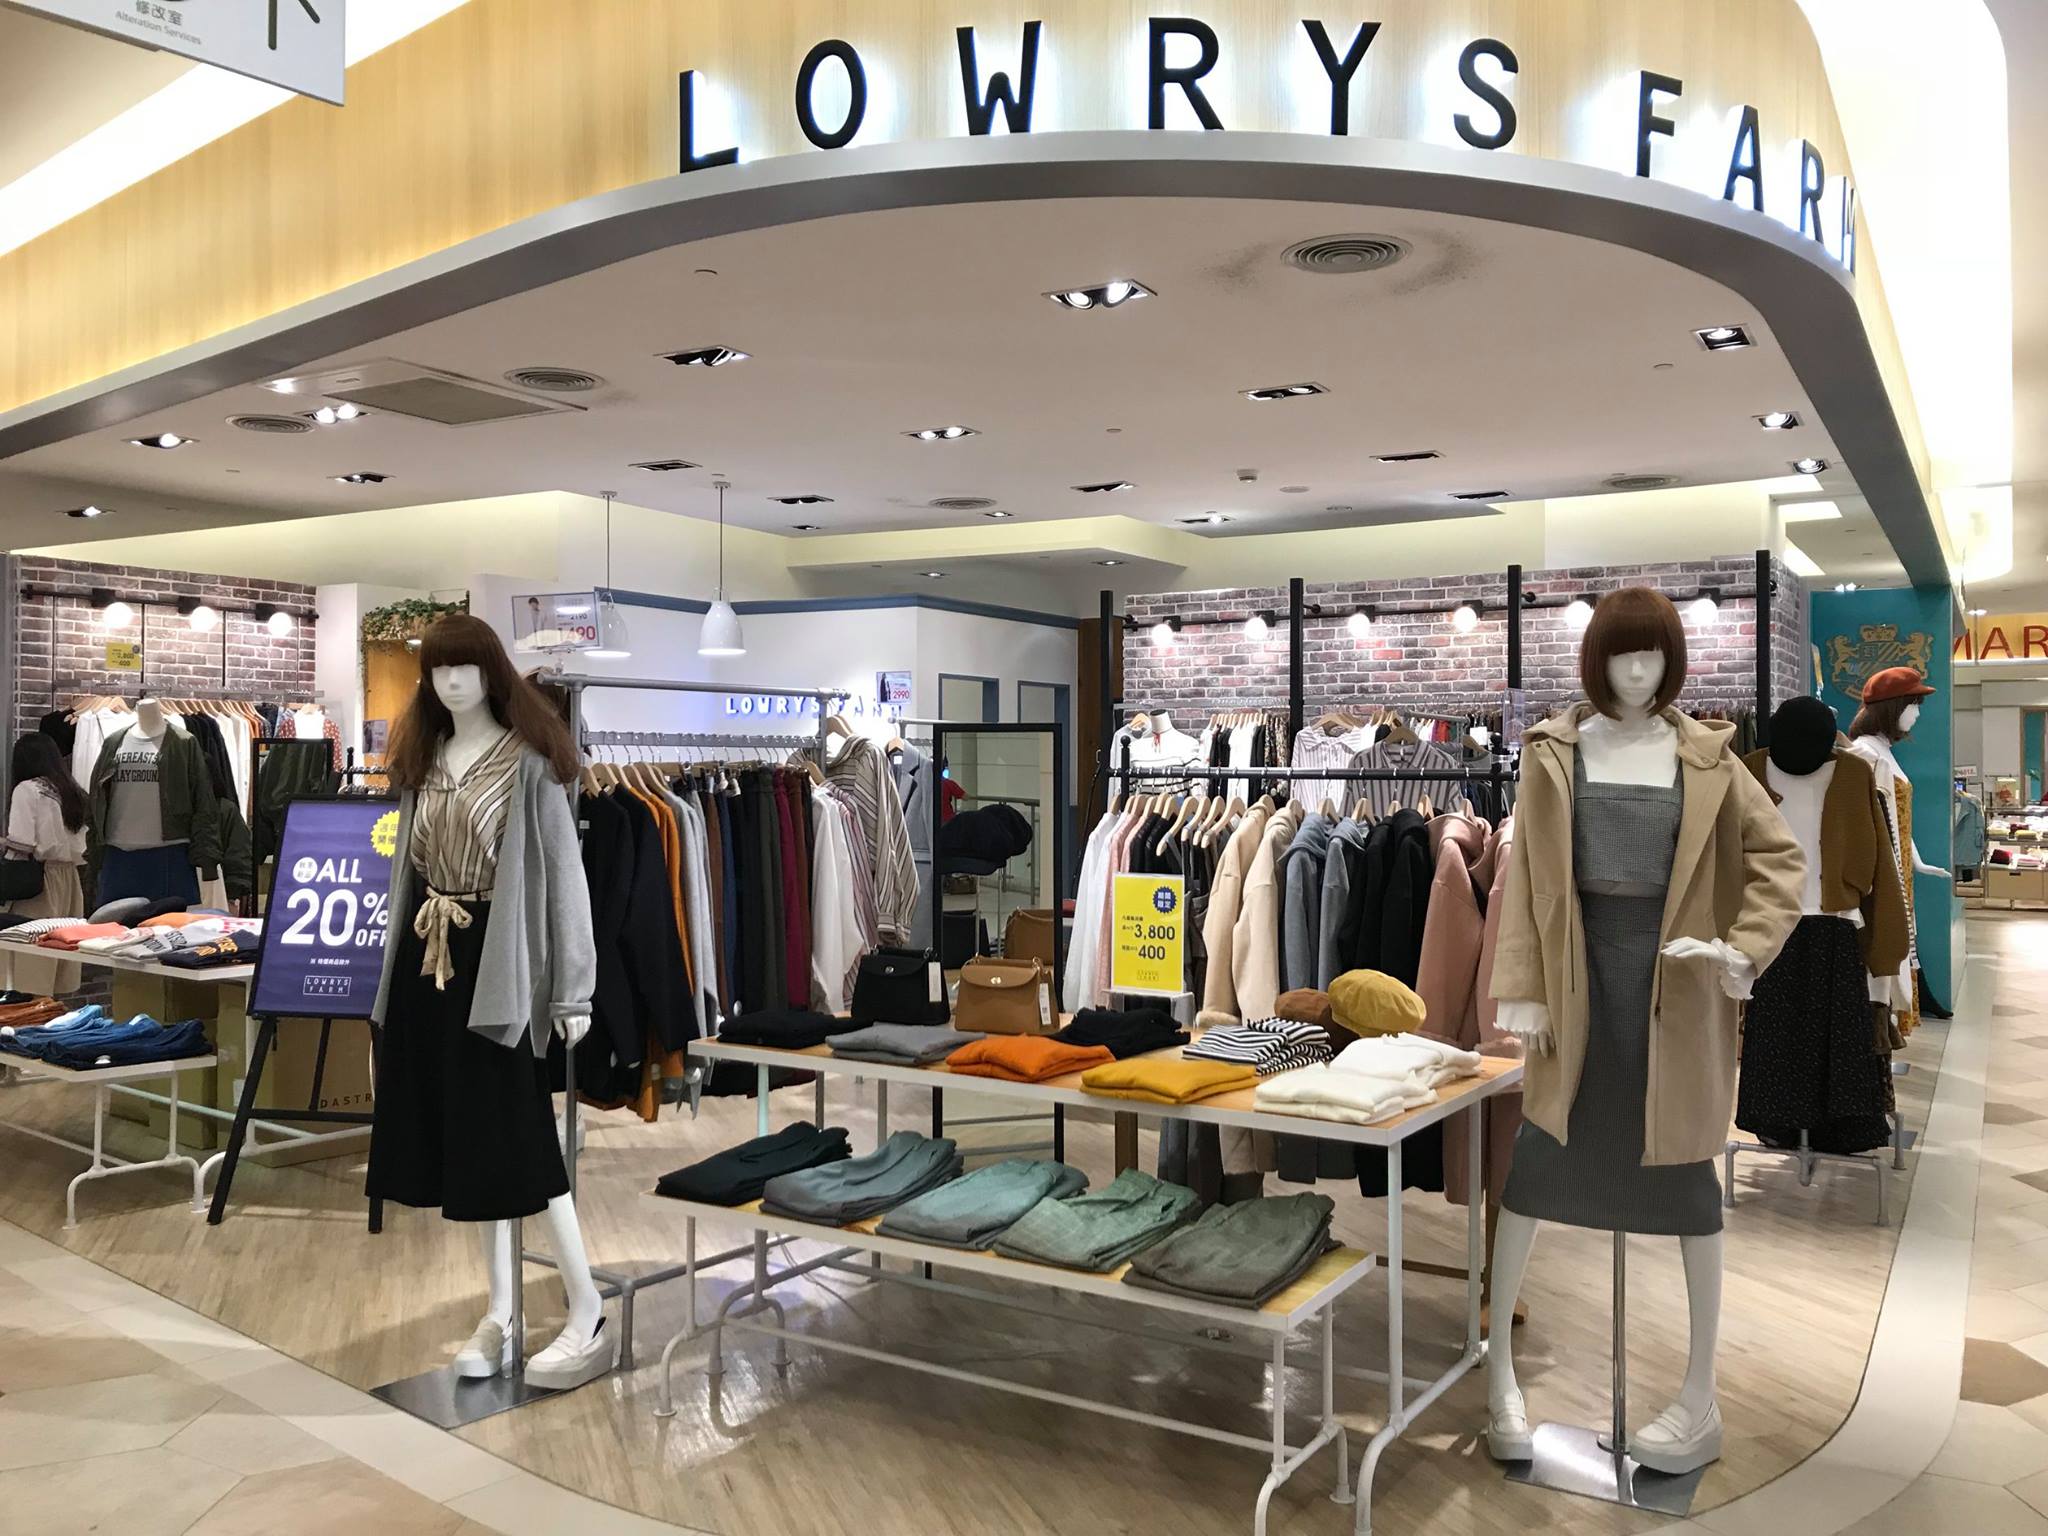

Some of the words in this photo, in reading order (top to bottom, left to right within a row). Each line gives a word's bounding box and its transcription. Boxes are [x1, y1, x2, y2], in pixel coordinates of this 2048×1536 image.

[115, 11, 162, 31] Alteration
[163, 25, 202, 45] Services
[679, 17, 1519, 174] LOWRYS
[725, 696, 820, 716] LOWRYS
[315, 858, 363, 883] ALL
[355, 929, 387, 947] OFF
[1134, 924, 1176, 941] 3,800
[1138, 945, 1166, 960] 400
[306, 978, 349, 986] LOWRYS
